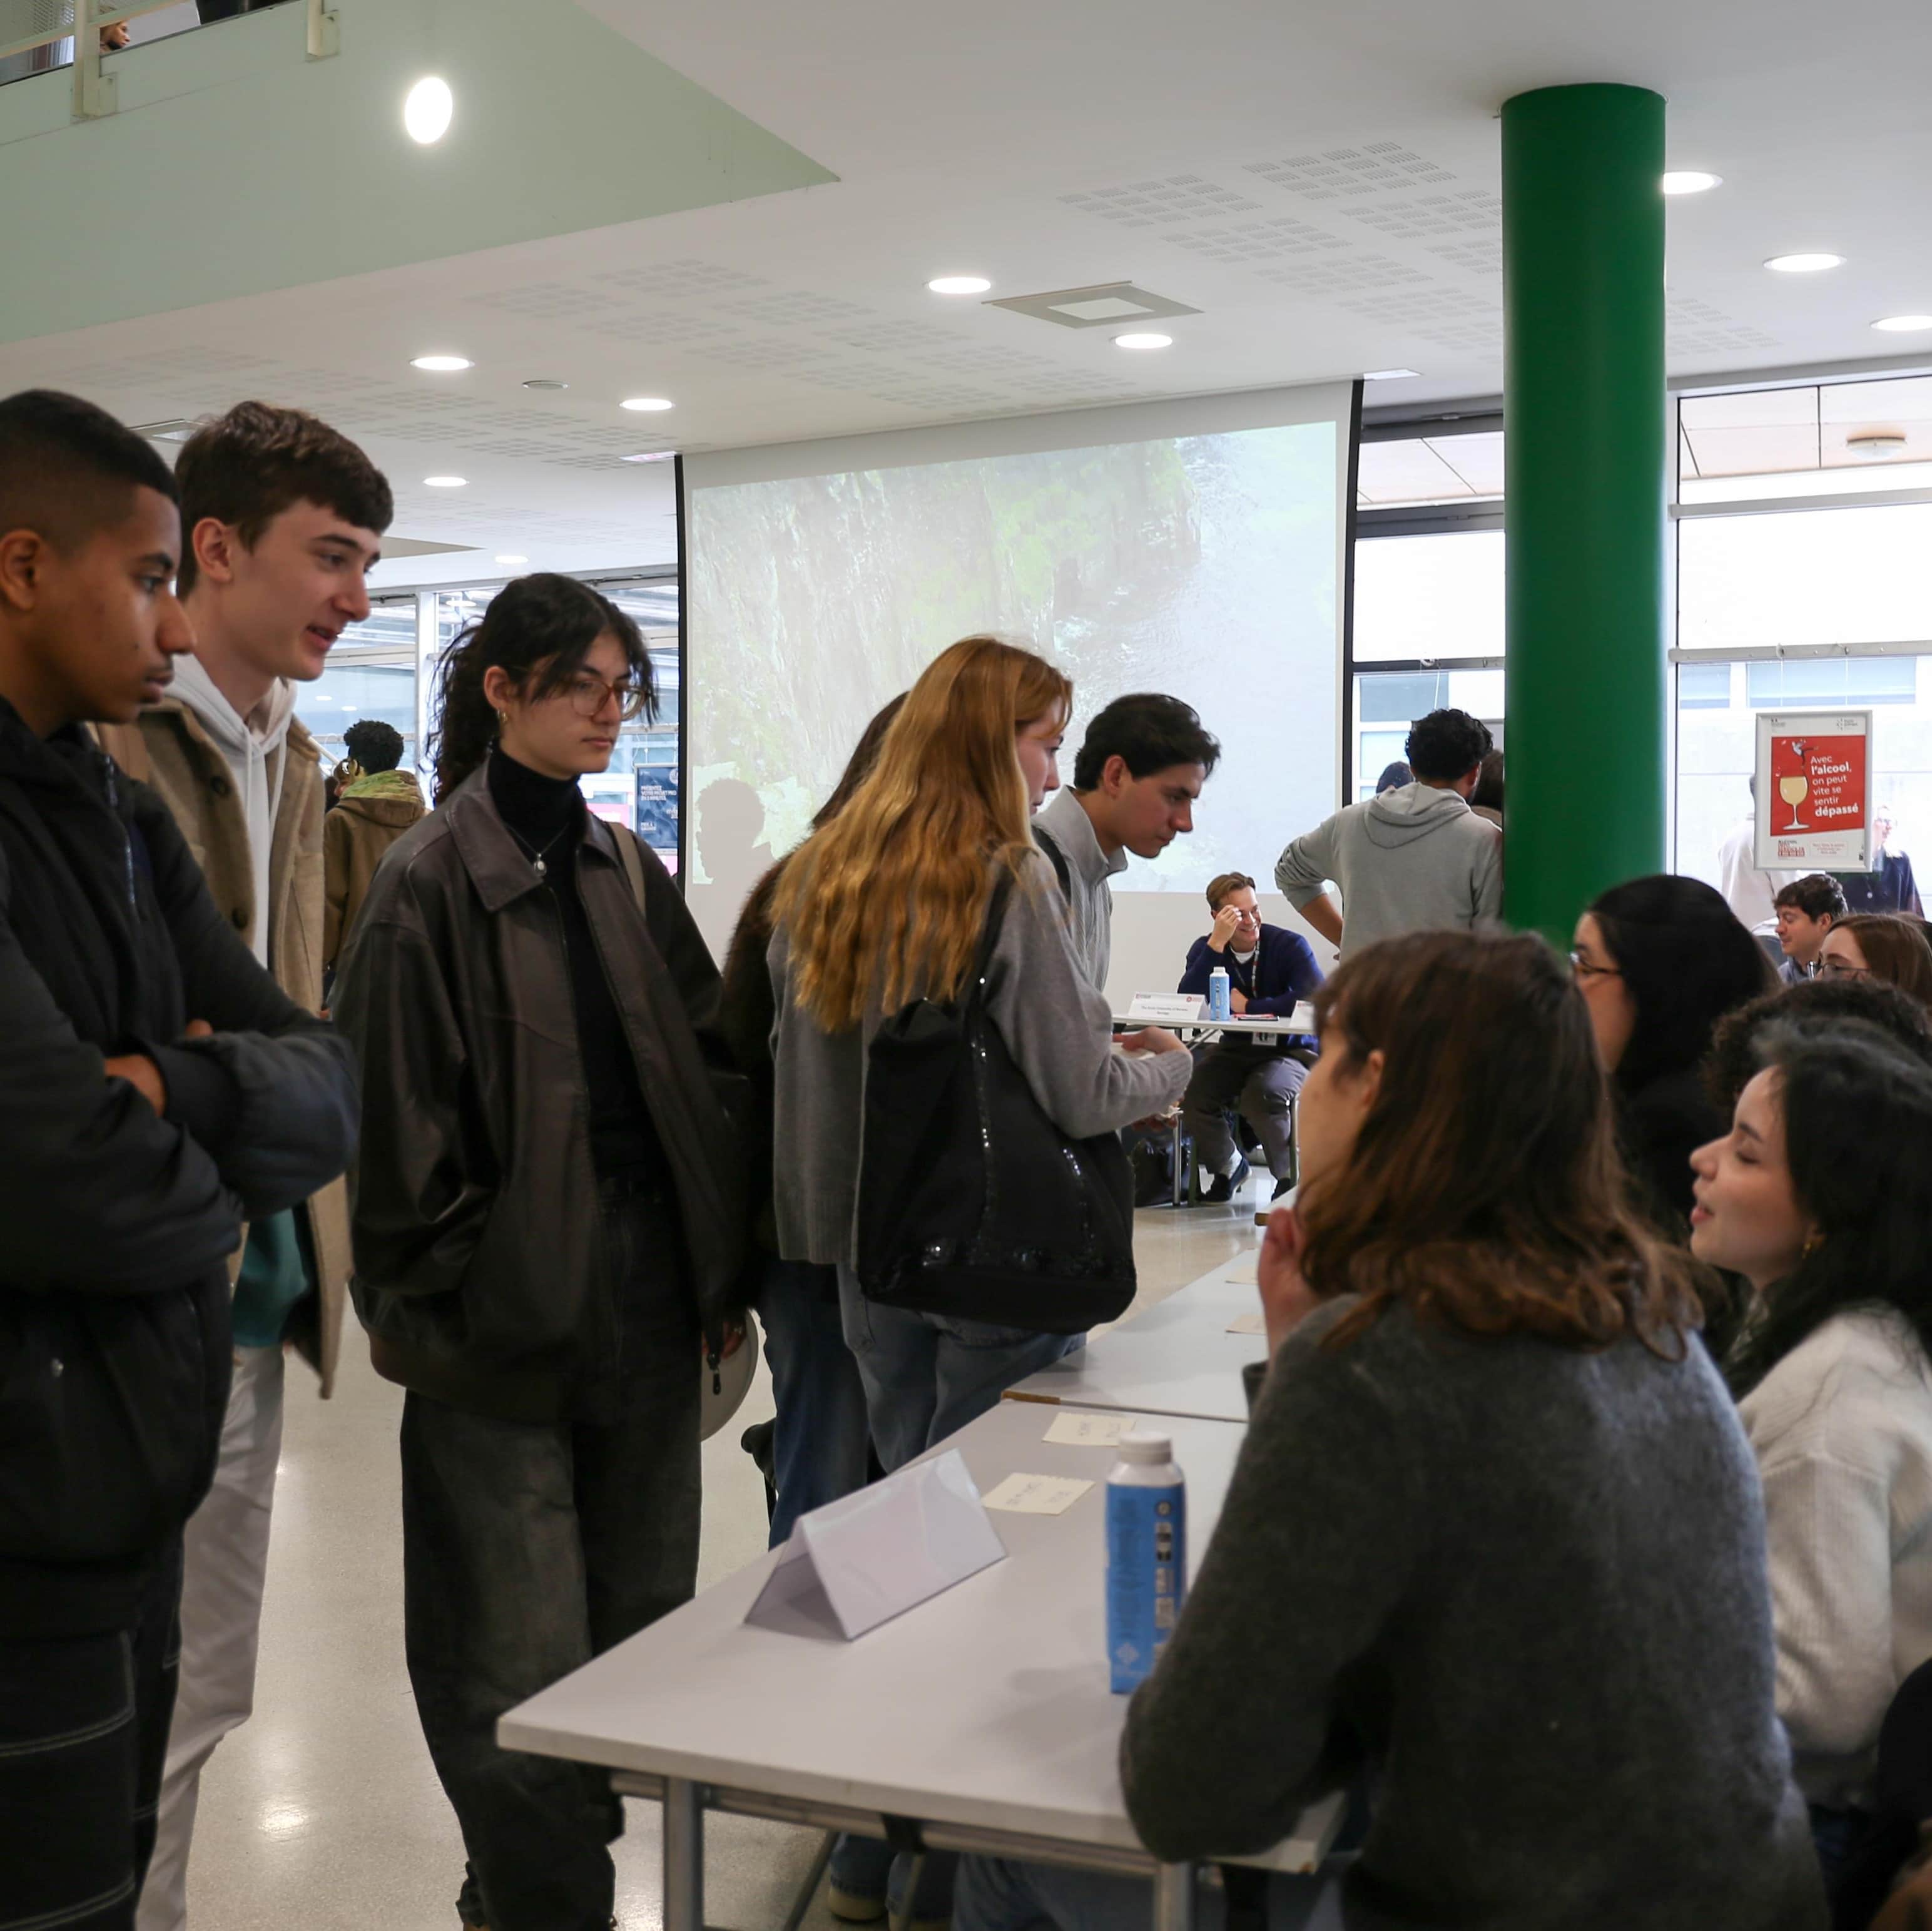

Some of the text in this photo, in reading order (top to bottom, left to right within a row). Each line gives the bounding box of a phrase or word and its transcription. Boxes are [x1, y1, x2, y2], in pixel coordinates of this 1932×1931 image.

[1811, 755, 1833, 764] Avec
[1813, 775, 1847, 787] on peut
[1813, 786, 1842, 796] vite se
[1814, 795, 1839, 806] sentir
[1815, 802, 1859, 818] dépassé
